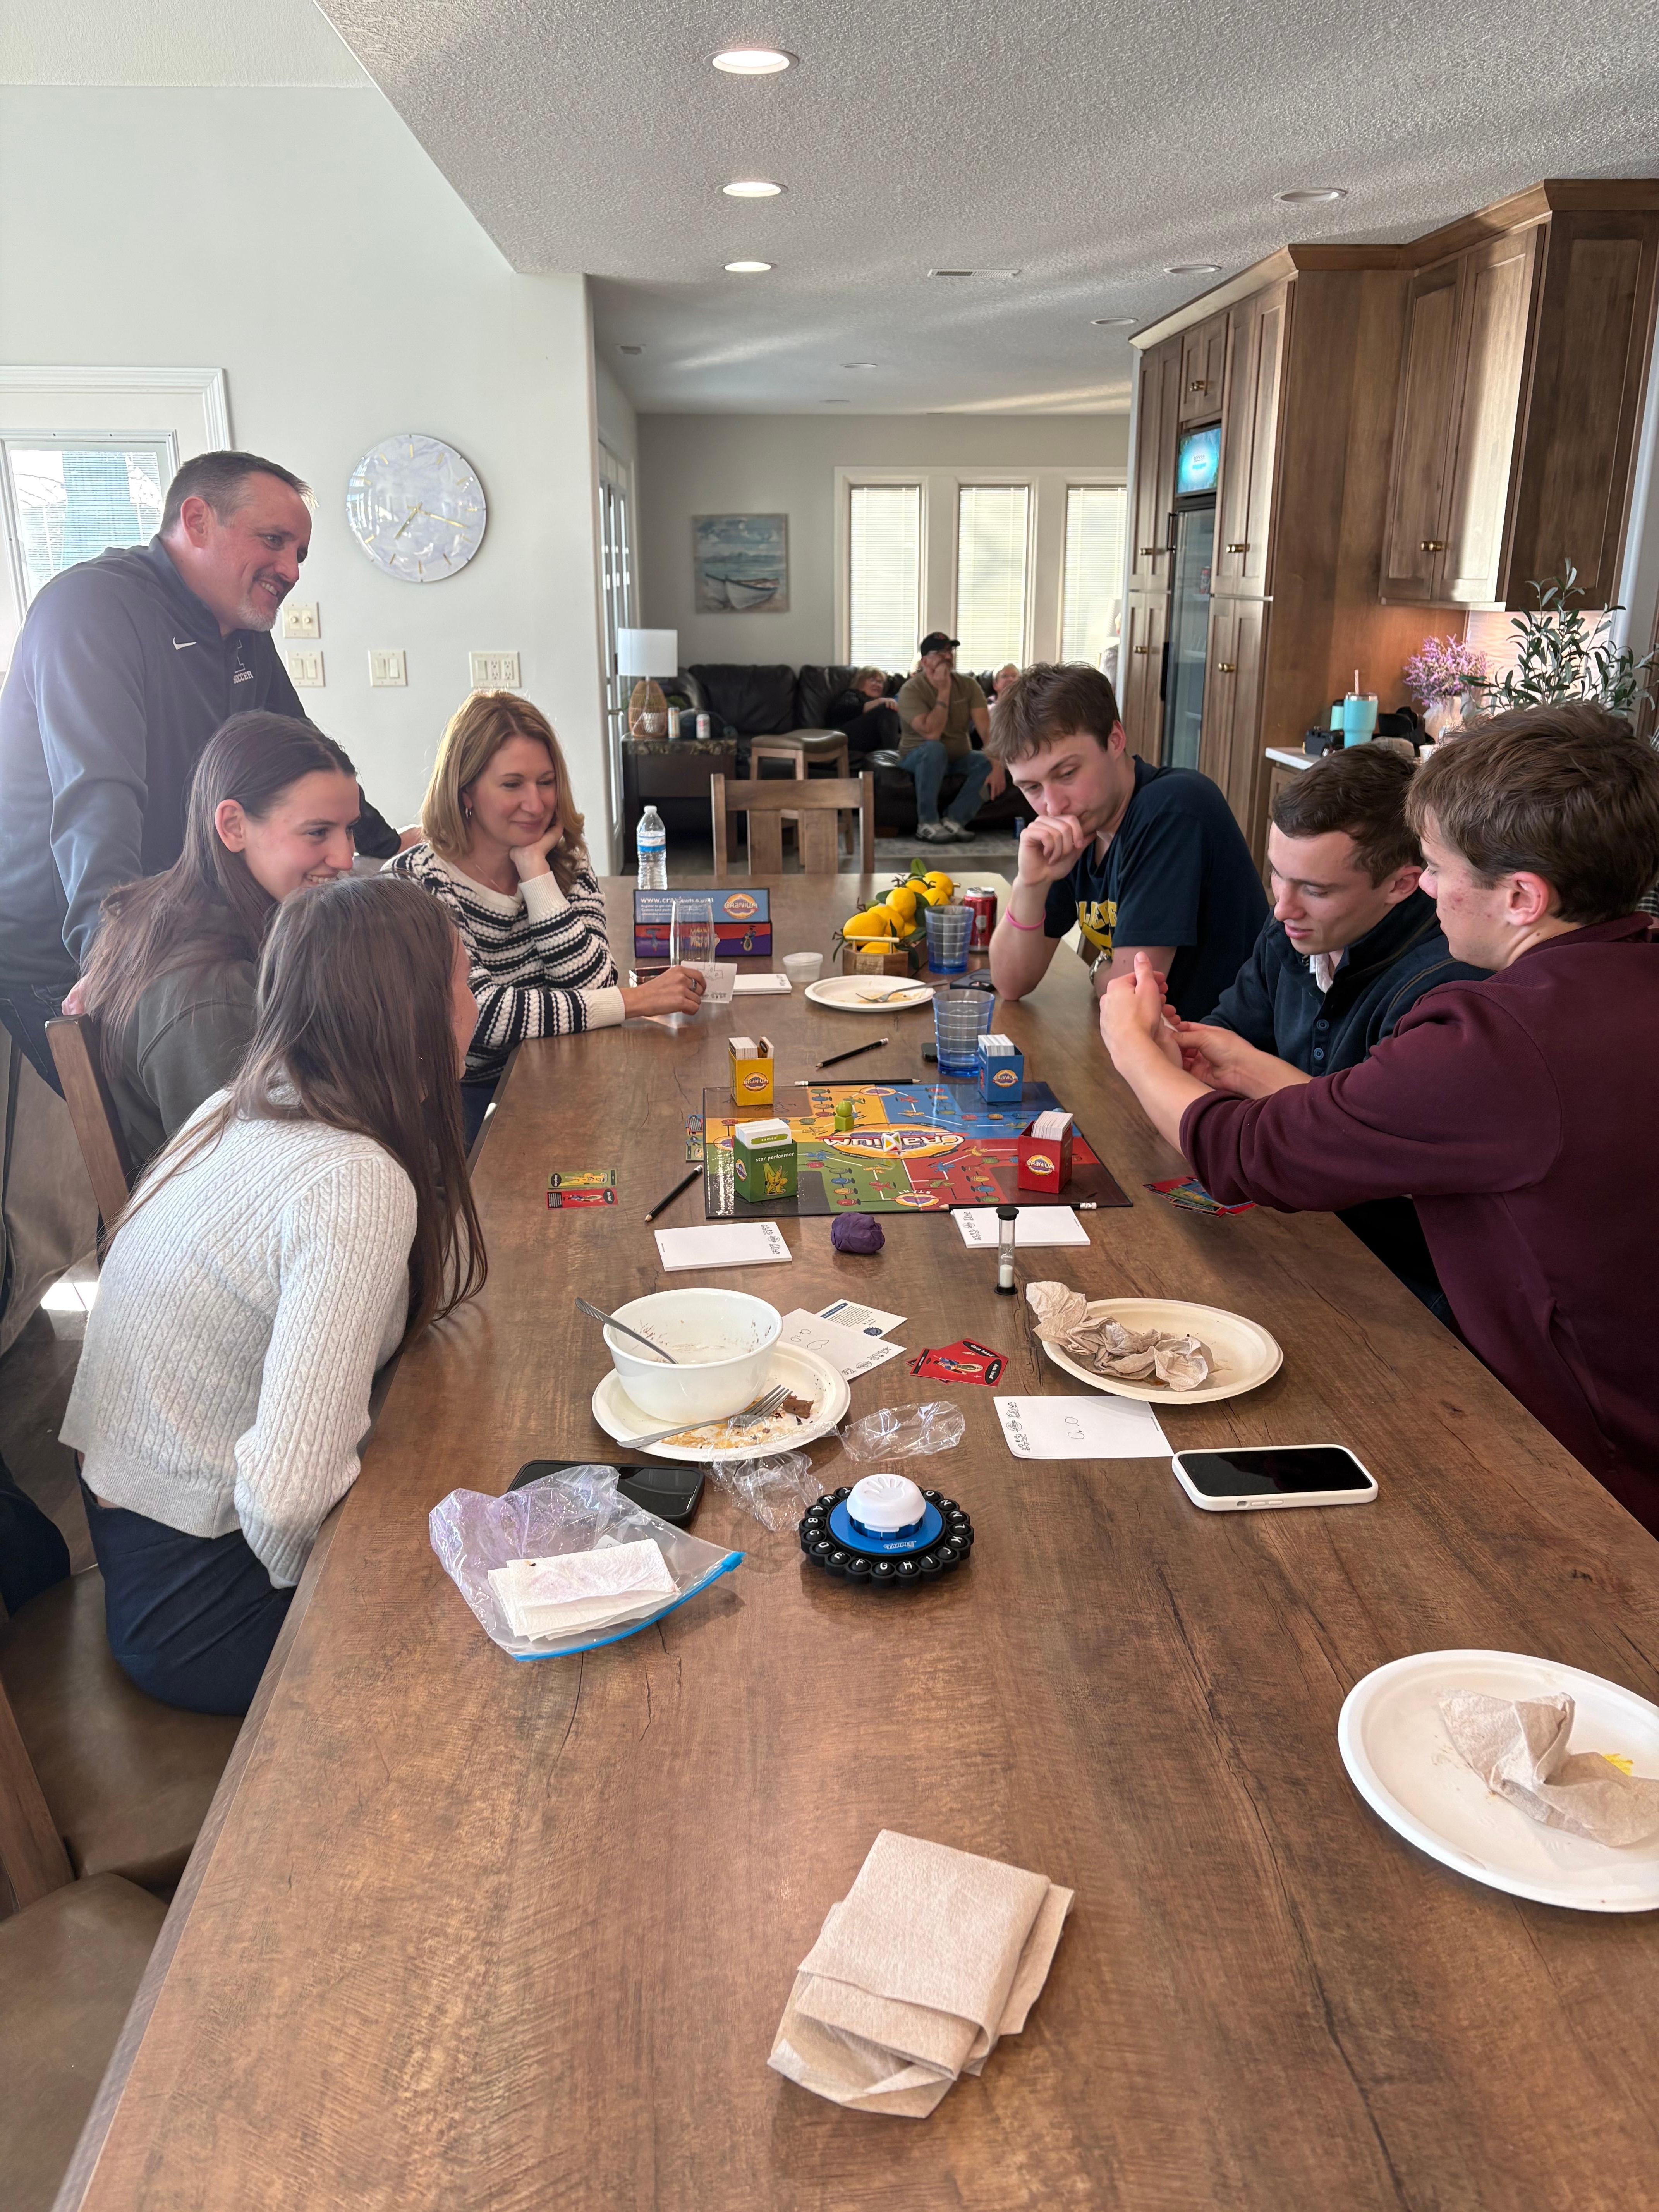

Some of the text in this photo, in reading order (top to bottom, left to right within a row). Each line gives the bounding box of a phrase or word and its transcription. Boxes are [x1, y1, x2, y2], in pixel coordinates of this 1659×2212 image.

[233, 670, 254, 684] SOCCER
[767, 1152, 795, 1161] performer
[903, 1561, 912, 1570] H
